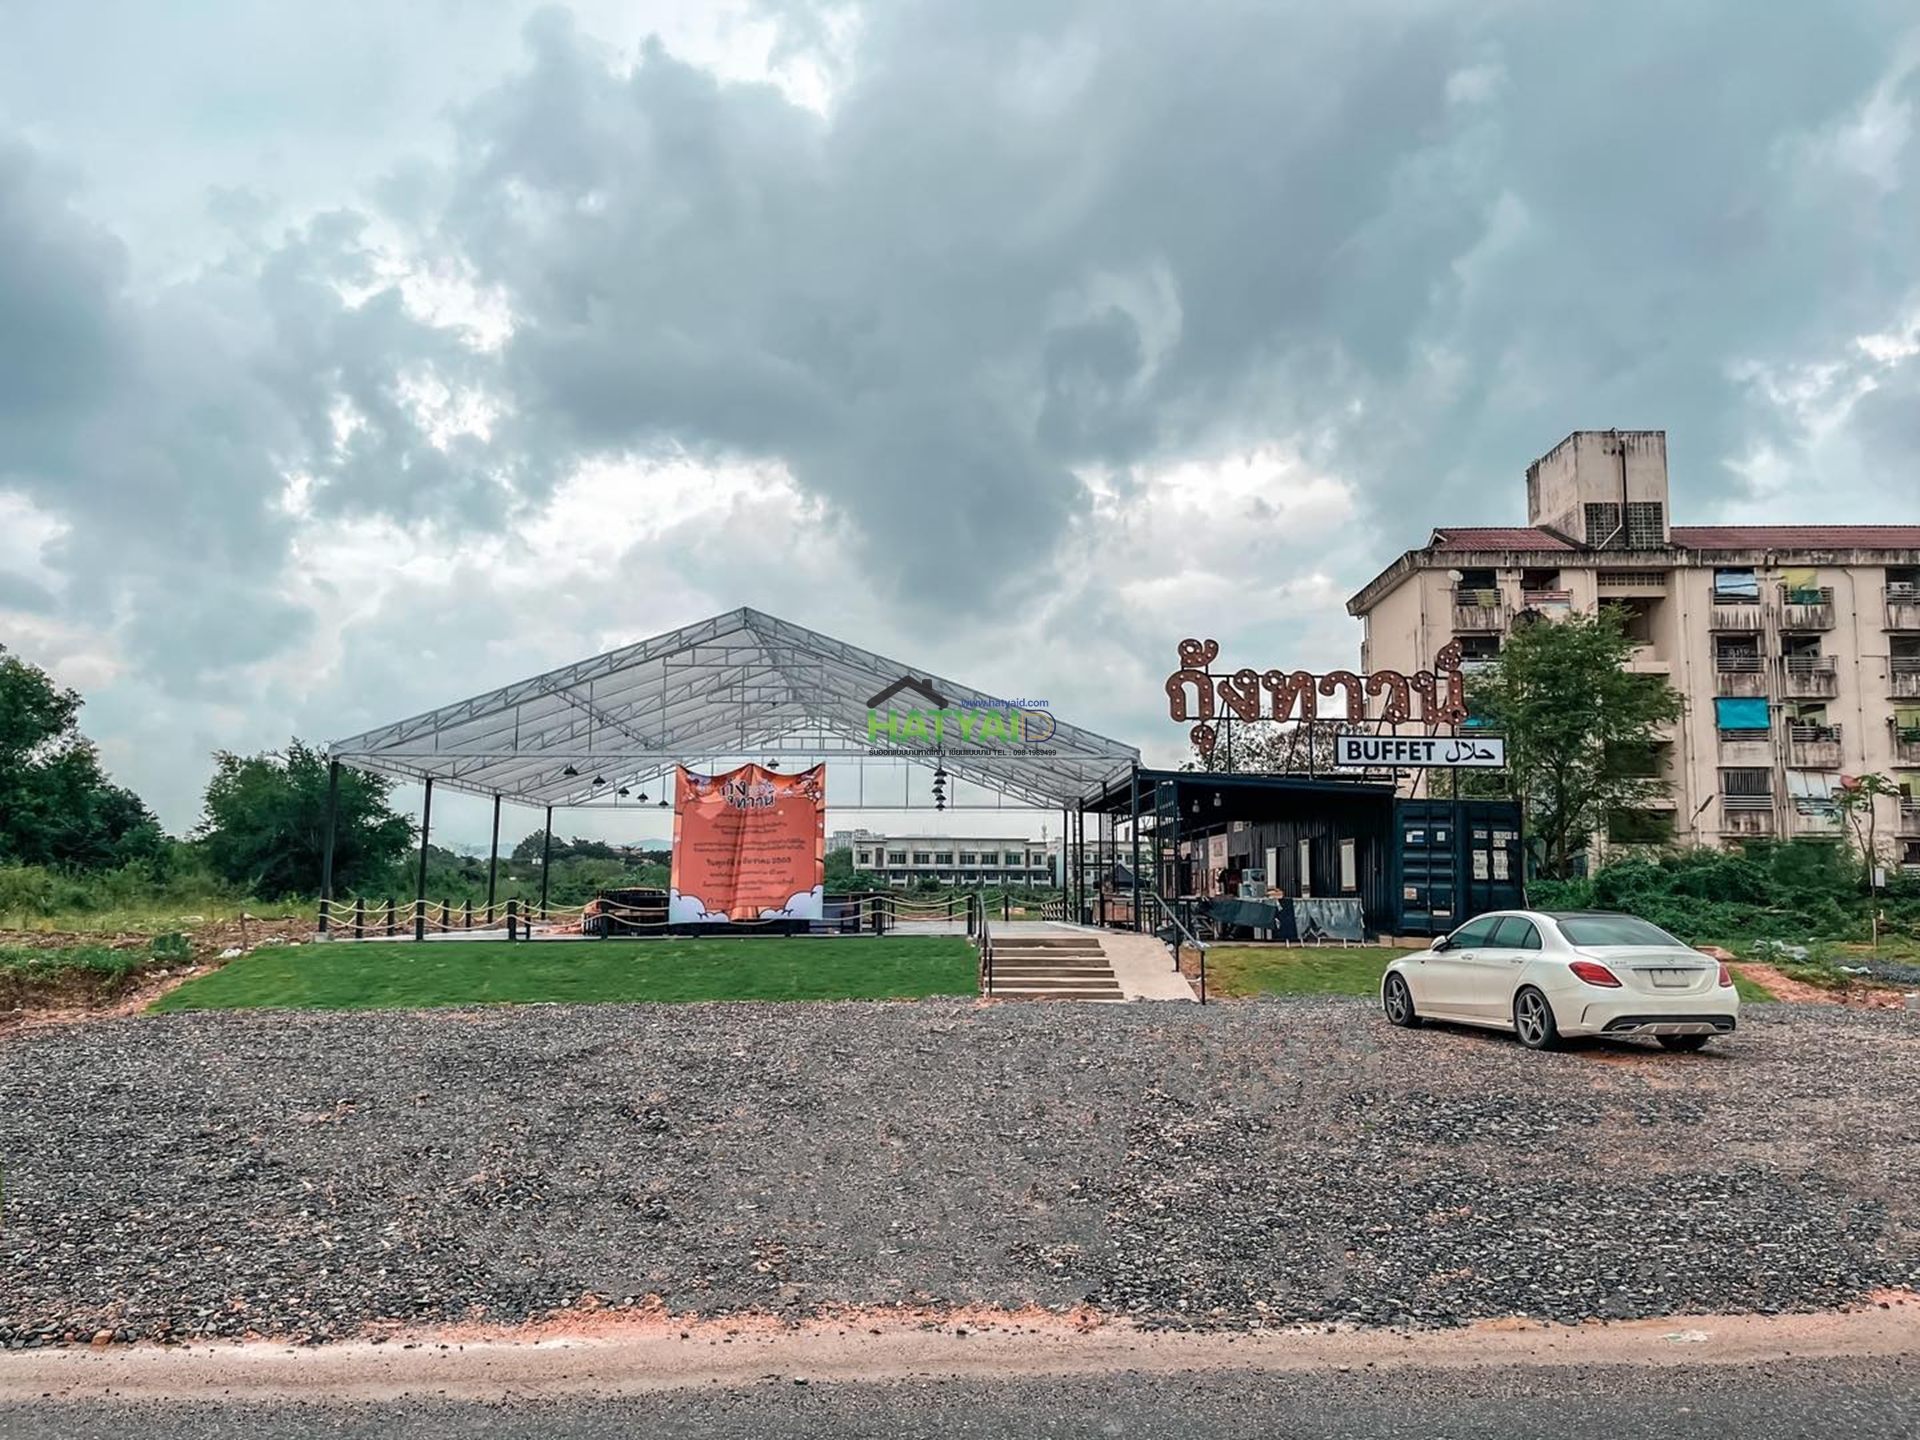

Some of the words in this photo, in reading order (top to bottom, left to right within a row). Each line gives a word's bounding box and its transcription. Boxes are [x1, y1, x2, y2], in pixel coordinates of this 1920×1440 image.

[1165, 638, 1468, 755] กุ้งทาวน์
[1346, 740, 1436, 762] BUFFET
[1444, 741, 1496, 763] حلال
